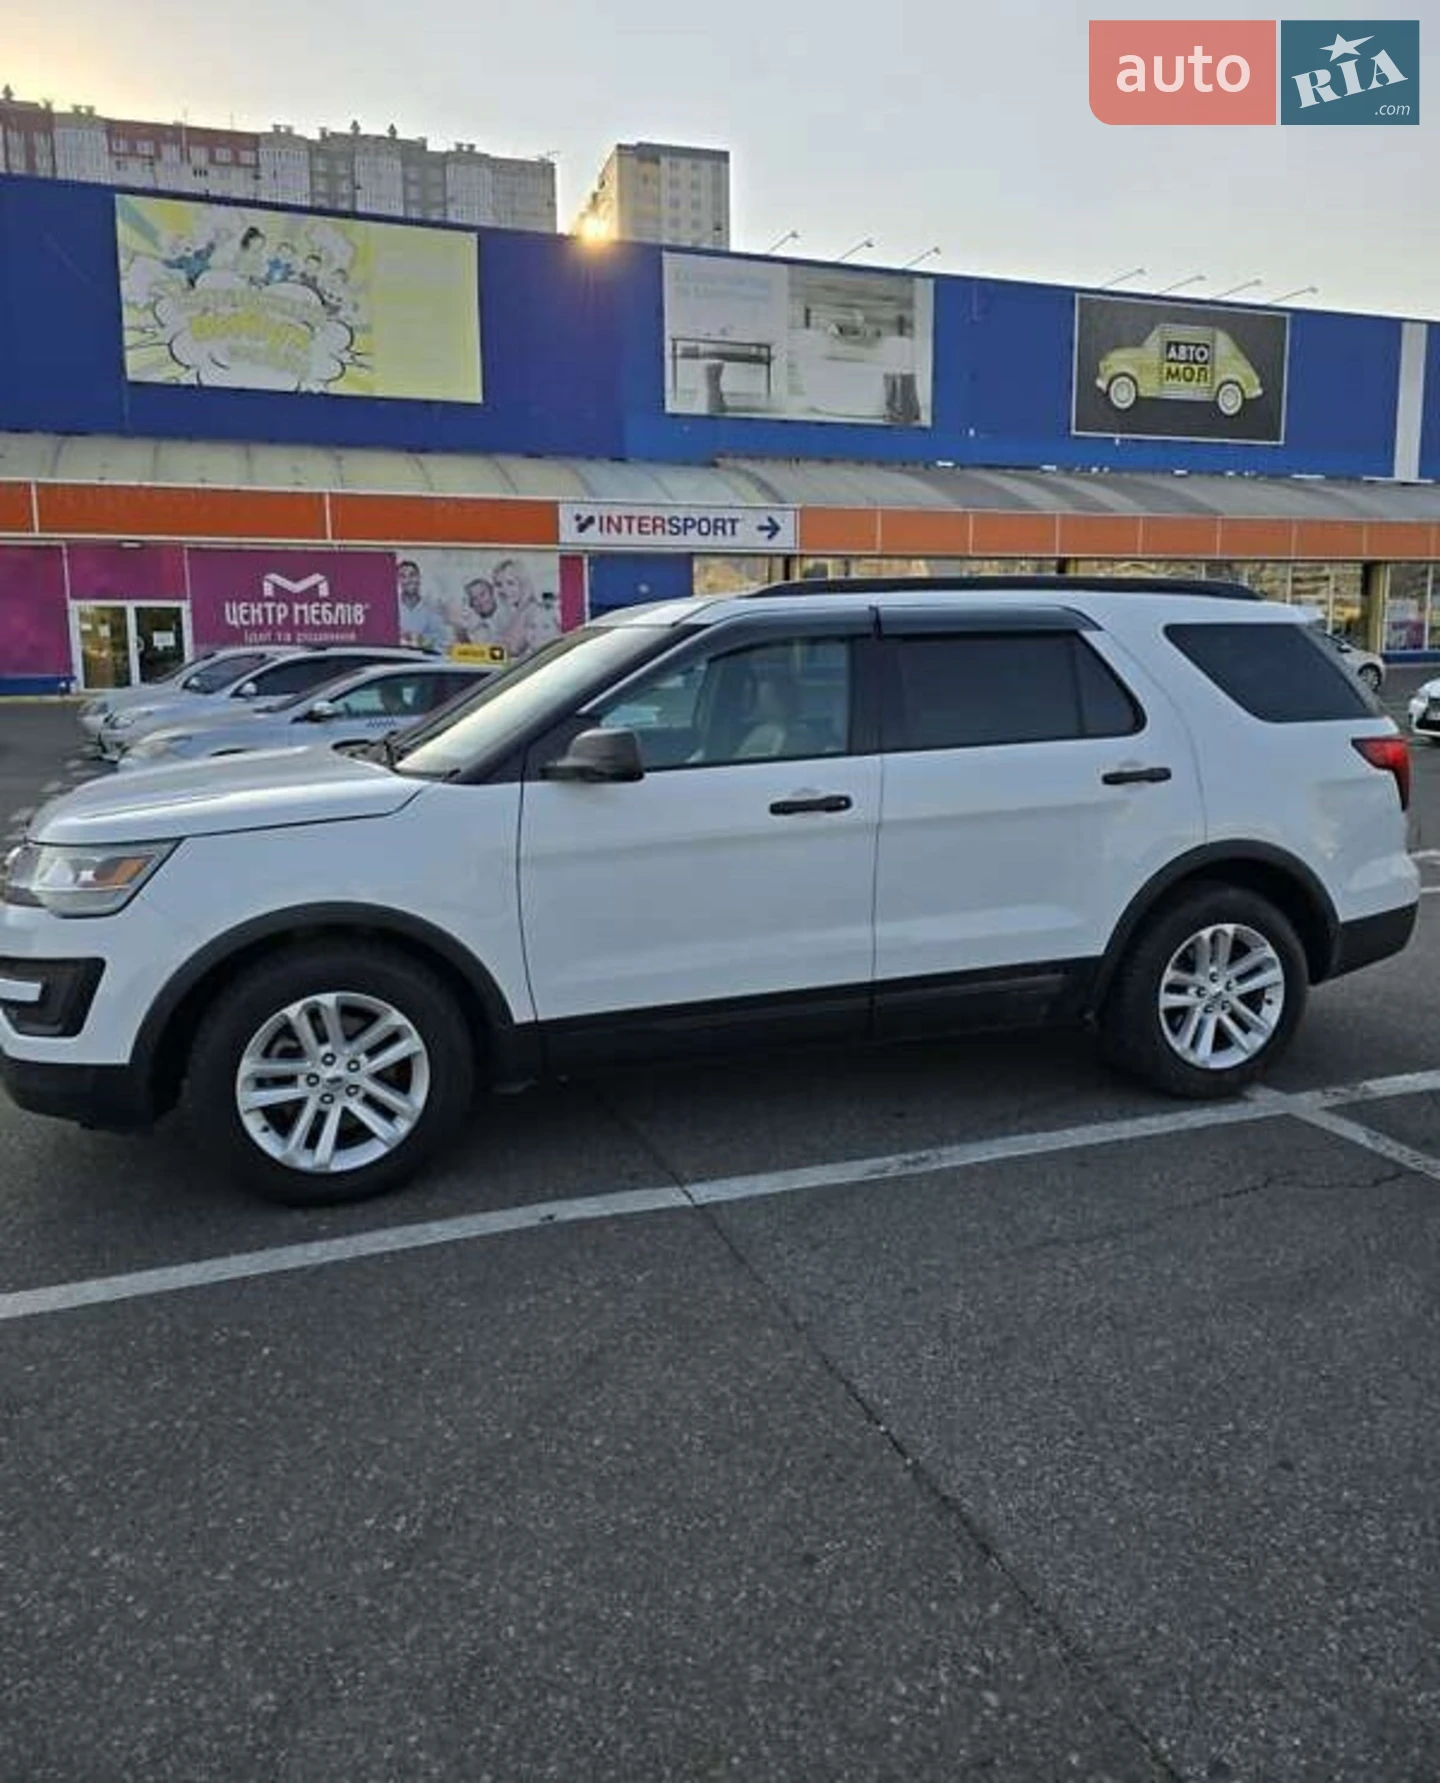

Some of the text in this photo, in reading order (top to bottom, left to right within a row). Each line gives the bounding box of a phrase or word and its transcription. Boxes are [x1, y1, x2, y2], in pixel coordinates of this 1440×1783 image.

[1168, 344, 1208, 362] АВТО
[1166, 367, 1208, 382] МОЛ
[599, 515, 740, 536] INTERSPORT
[225, 601, 289, 628] ЦЕНТР
